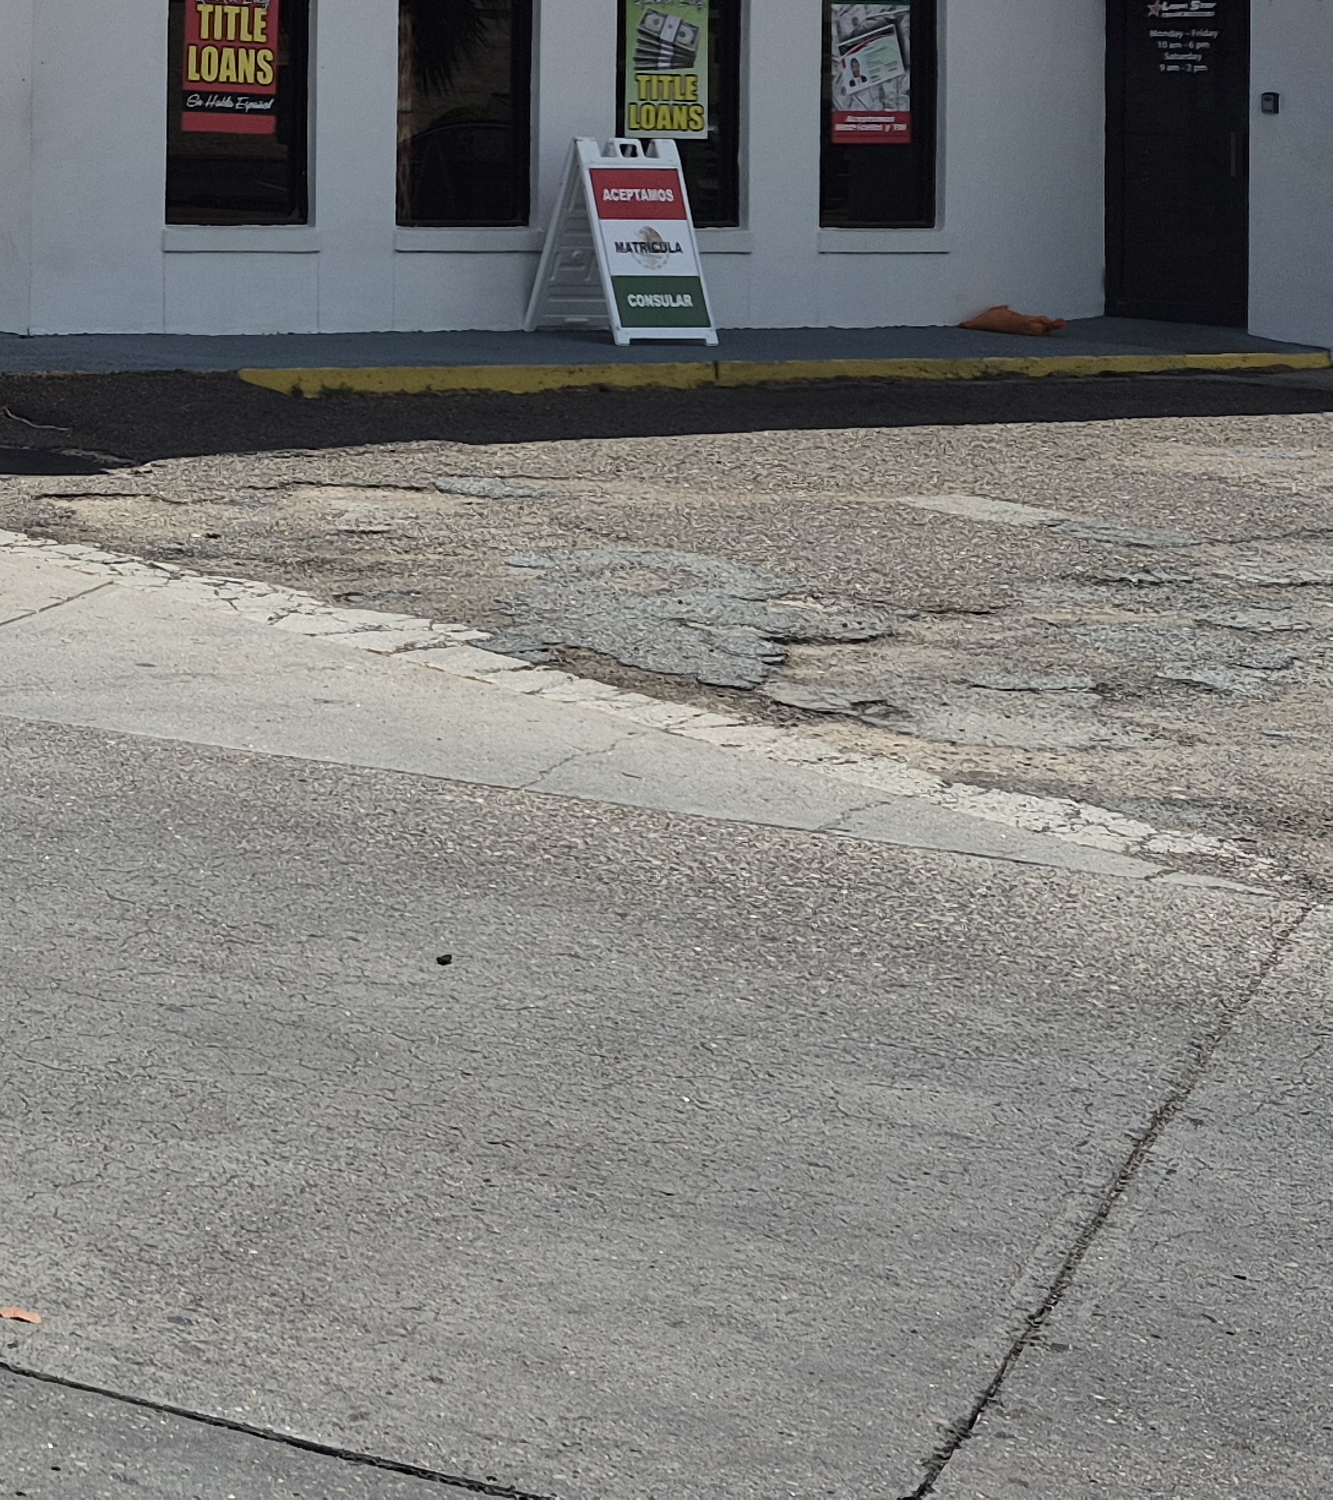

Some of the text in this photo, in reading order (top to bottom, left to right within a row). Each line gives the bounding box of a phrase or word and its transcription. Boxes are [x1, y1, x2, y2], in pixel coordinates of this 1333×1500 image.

[197, 3, 267, 43] TITLE
[188, 45, 274, 86] LOANS
[635, 74, 698, 101] TITLE
[628, 102, 704, 131] LOANS
[602, 188, 674, 202] ACEPTAMOS
[614, 241, 684, 254] MATRICULA
[627, 293, 694, 308] CONSULAR
